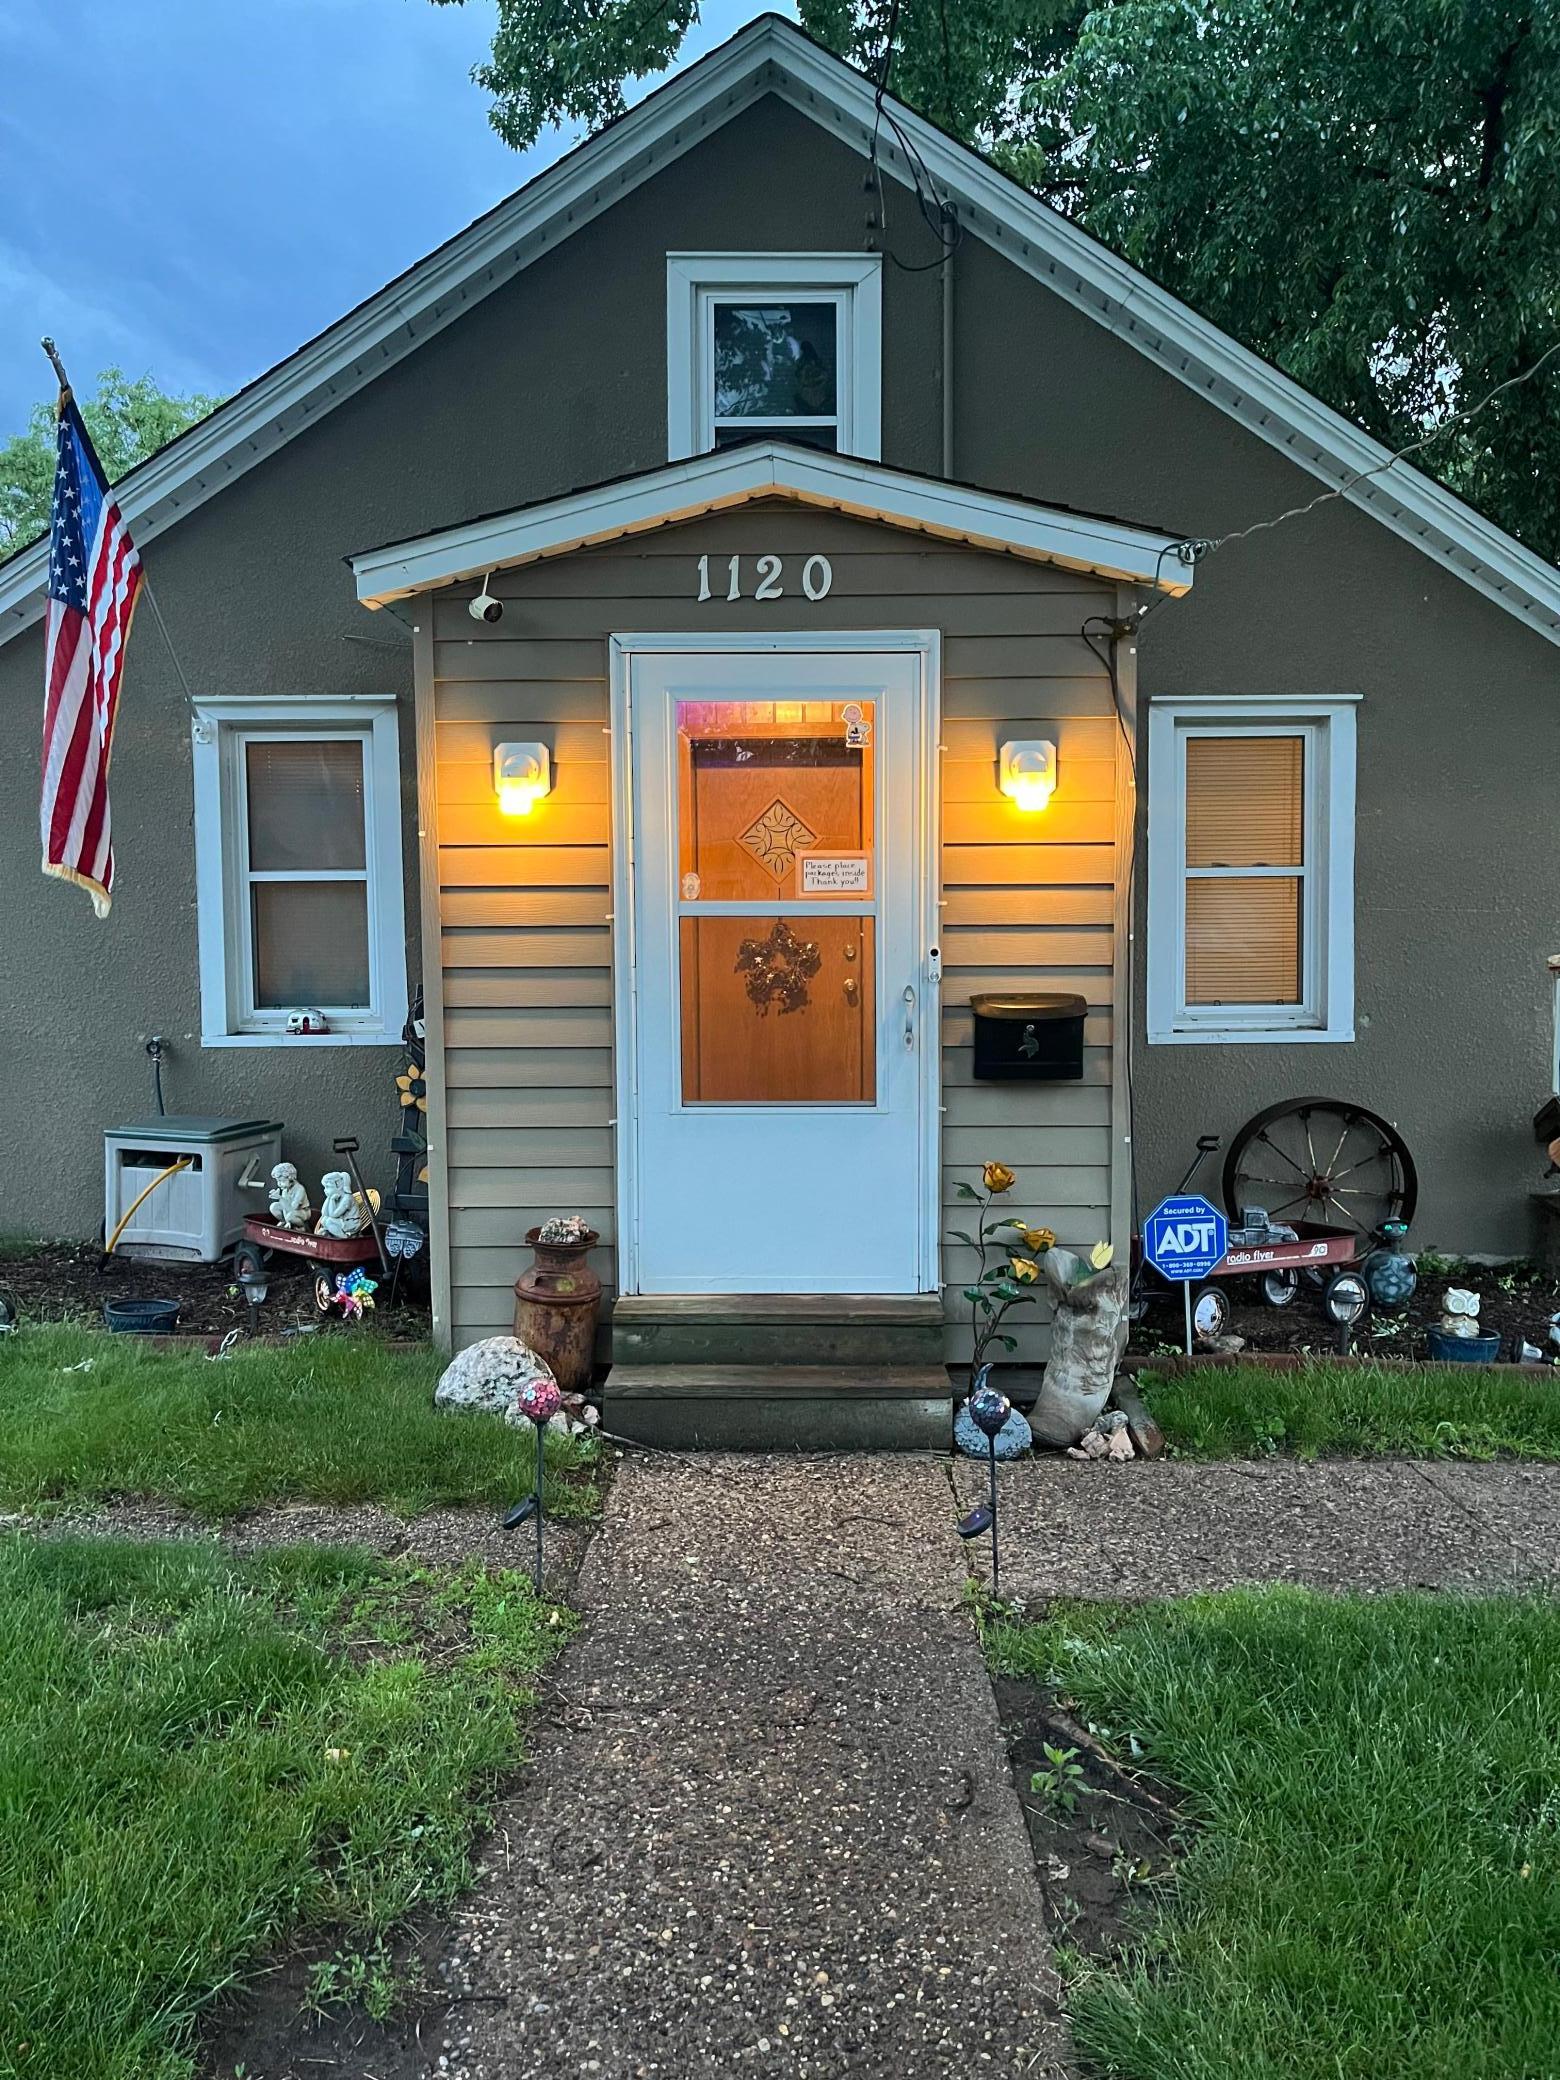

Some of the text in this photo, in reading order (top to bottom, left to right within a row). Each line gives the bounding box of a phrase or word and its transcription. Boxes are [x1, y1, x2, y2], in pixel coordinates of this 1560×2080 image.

[697, 554, 833, 601] 1120
[805, 861, 855, 872] Please place
[812, 876, 838, 885] Thank
[1163, 1206, 1206, 1215] Secured by
[1156, 1223, 1215, 1254] ADT
[1226, 1250, 1275, 1263] radio flyer
